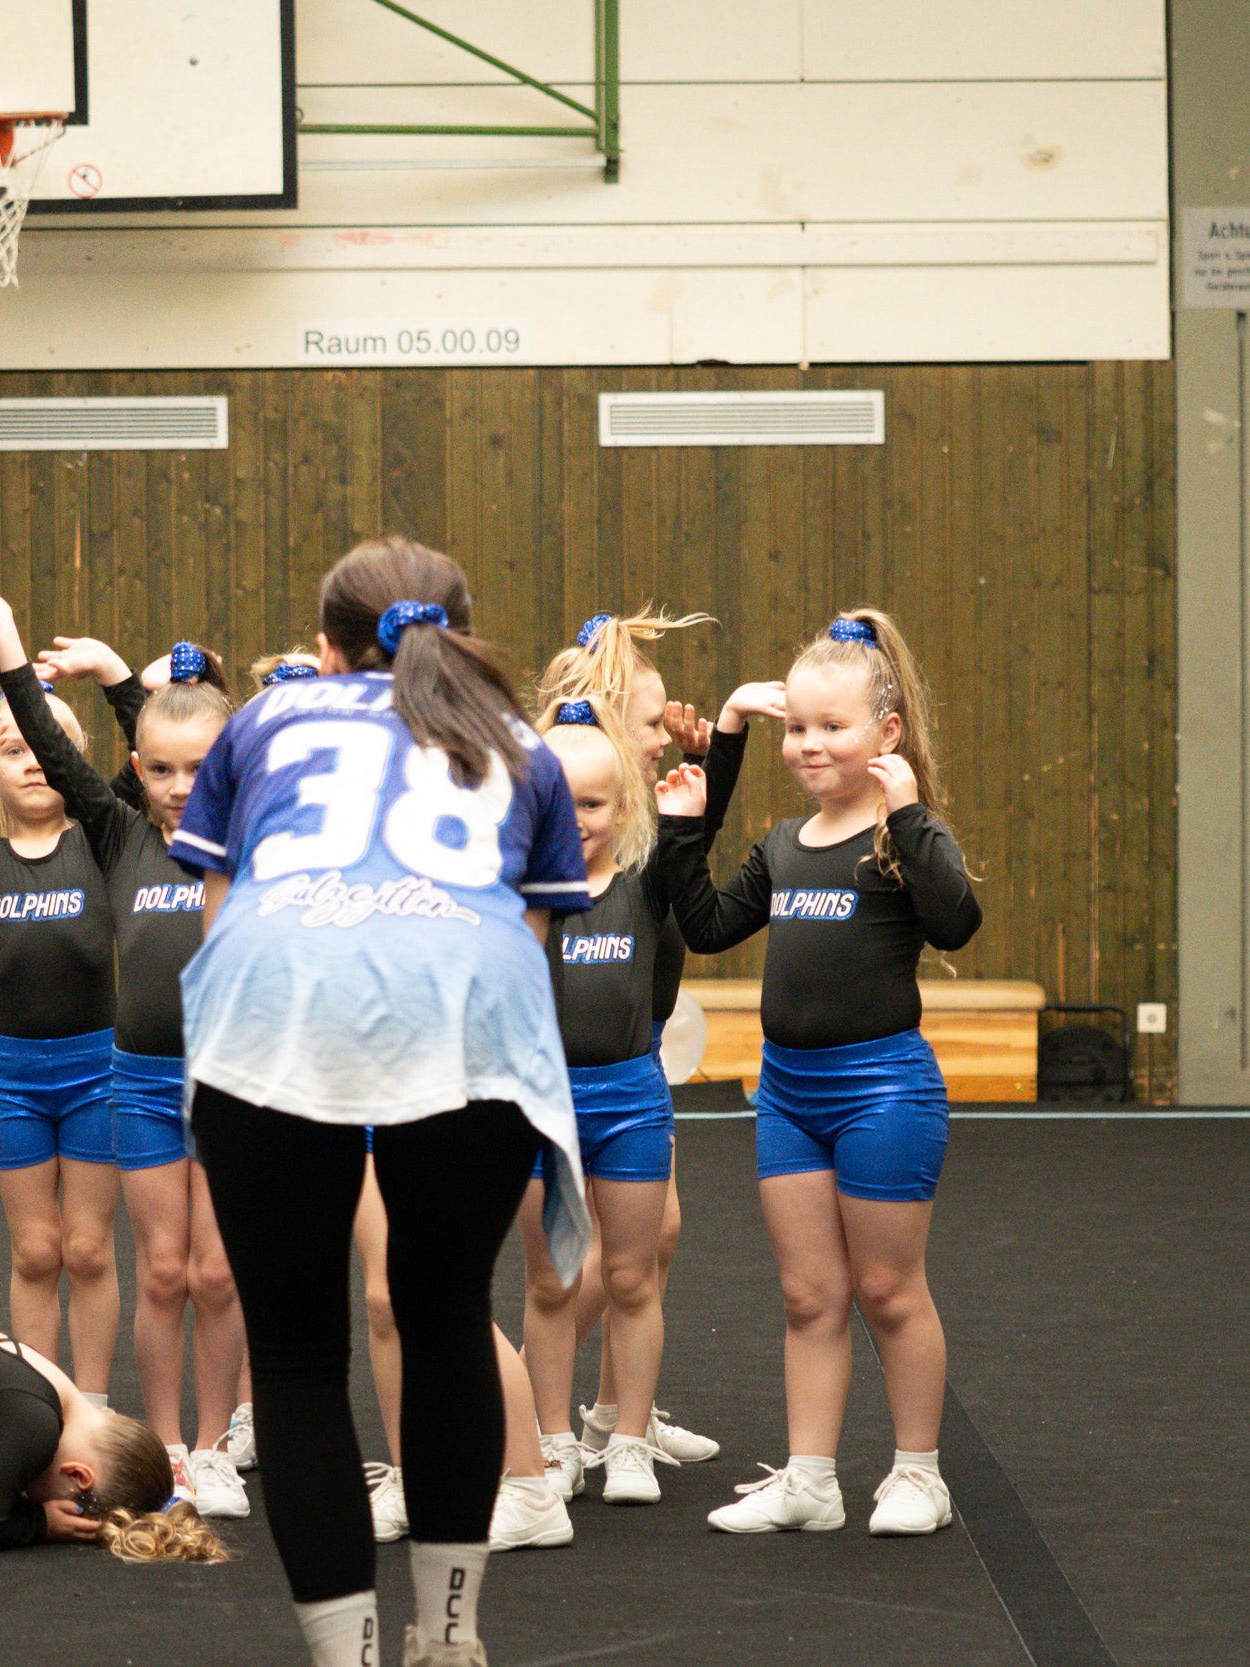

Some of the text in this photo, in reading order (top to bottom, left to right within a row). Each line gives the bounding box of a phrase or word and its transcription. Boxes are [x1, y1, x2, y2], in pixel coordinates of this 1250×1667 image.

[304, 328, 520, 354] Raum 05.00.09
[252, 719, 514, 888] 38
[562, 936, 632, 961] LPHINS
